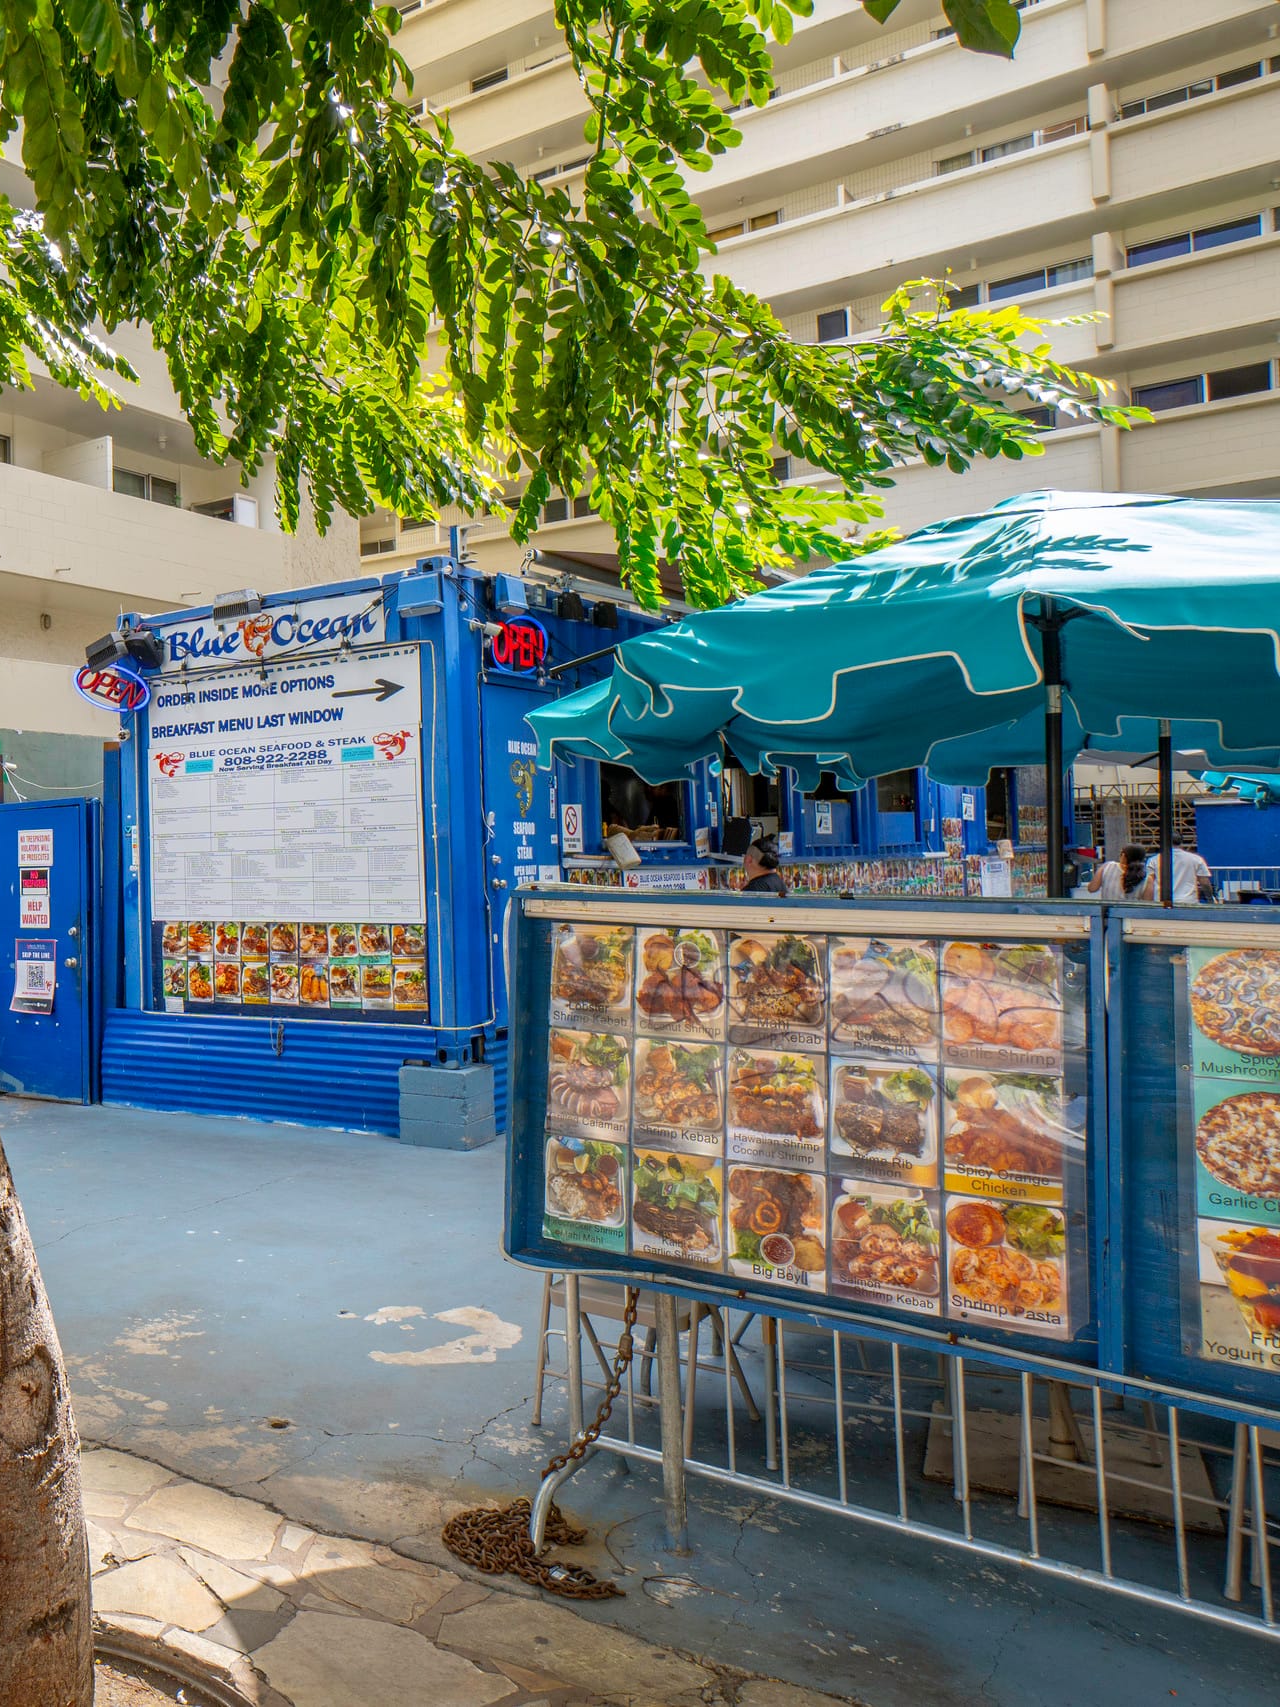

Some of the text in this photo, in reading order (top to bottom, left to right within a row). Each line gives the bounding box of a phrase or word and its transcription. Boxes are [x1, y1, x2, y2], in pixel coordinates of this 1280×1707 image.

[170, 610, 379, 662] Blue Ocean
[493, 621, 544, 667] OPEN
[78, 669, 145, 708] OPEN
[157, 674, 335, 708] ORDER INSIDE MORE OPTIONS
[151, 707, 344, 739] BREAKFAST MENU LAST WINDOW
[189, 736, 366, 758] BLUE OCEAN SEAFOOD & STEAK
[508, 740, 537, 756] BLUE OCEAN
[224, 750, 327, 766] 808-922-2288
[237, 763, 265, 773] Serving
[266, 760, 302, 769] Breakfast
[304, 759, 317, 767] All
[318, 758, 332, 767] Day
[513, 822, 535, 835] SEAFOOD
[517, 846, 533, 859] STEAK
[28, 901, 42, 911] HELP
[22, 914, 47, 924] WANTED
[568, 1001, 609, 1013] Lobster
[553, 1010, 590, 1023] Shrimp
[639, 1020, 721, 1037] Coconut Shrimp
[783, 1031, 821, 1045] Kebab
[895, 1045, 916, 1056] Rib
[946, 1045, 1055, 1066] Garlic Shrimp
[583, 1118, 625, 1132] Calamari
[638, 1123, 719, 1145] Shrimp Kebab
[733, 1133, 819, 1152] Hawaiian Shrimp
[733, 1145, 814, 1165] Coconut Shrimp
[892, 1158, 912, 1170] Rib
[956, 1164, 1049, 1187] Spicy Orange
[971, 1180, 1027, 1197] Chicken
[1209, 1193, 1258, 1210] Garlic
[594, 1225, 624, 1238] Shrimp
[643, 1244, 671, 1256] Garlic
[753, 1264, 772, 1279] Big
[840, 1273, 881, 1289] Salmon
[854, 1288, 934, 1309] Shrimp Kebab
[952, 1295, 1061, 1325] Shrimp Pasta
[1205, 1339, 1264, 1363] Yogurt
